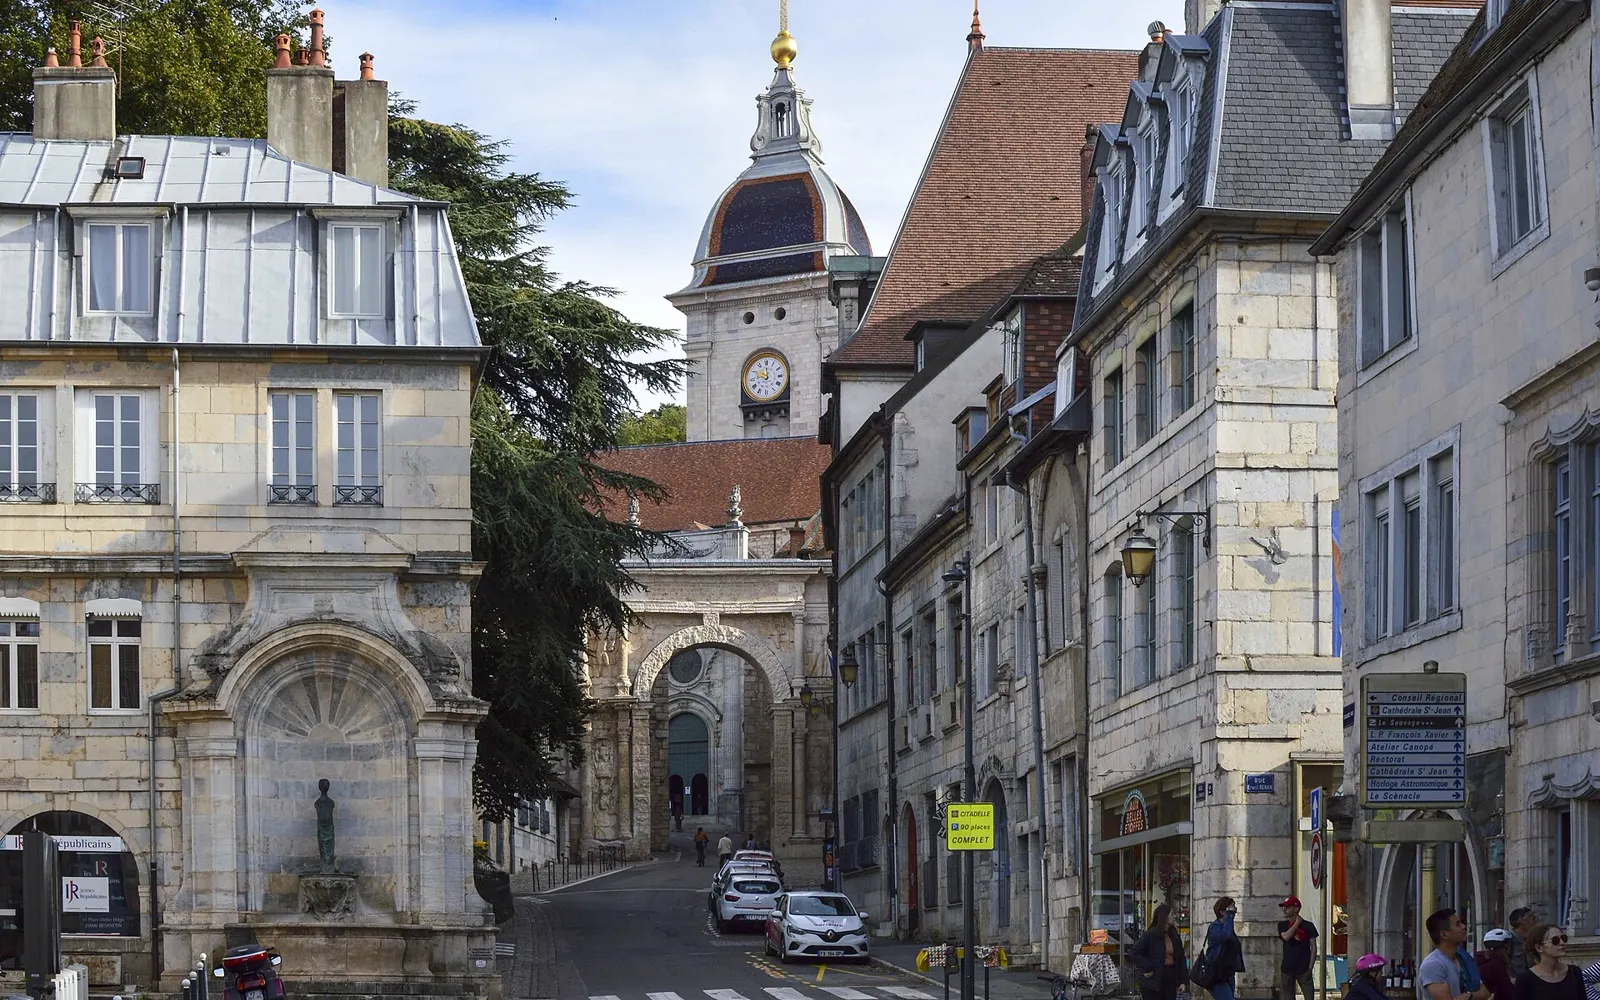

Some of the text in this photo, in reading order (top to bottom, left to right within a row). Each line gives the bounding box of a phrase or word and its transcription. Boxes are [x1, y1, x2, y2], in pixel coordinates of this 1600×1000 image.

[1391, 693, 1462, 703] Conseil Régional
[1382, 706, 1422, 715] Cathédrale
[1390, 719, 1421, 727] Sauvage
[1387, 731, 1421, 740] François
[1424, 731, 1449, 739] Xavier
[1370, 743, 1434, 753] Atelier Canopé
[1370, 755, 1405, 763] Rectorat
[1428, 767, 1448, 775] Jean
[1370, 780, 1448, 789] Horloge Astronomique
[1370, 792, 1379, 800] Le
[1128, 800, 1140, 811] AUX
[1126, 809, 1143, 823] BELLES
[54, 838, 112, 849] épublicains
[951, 836, 989, 844] COMPLET
